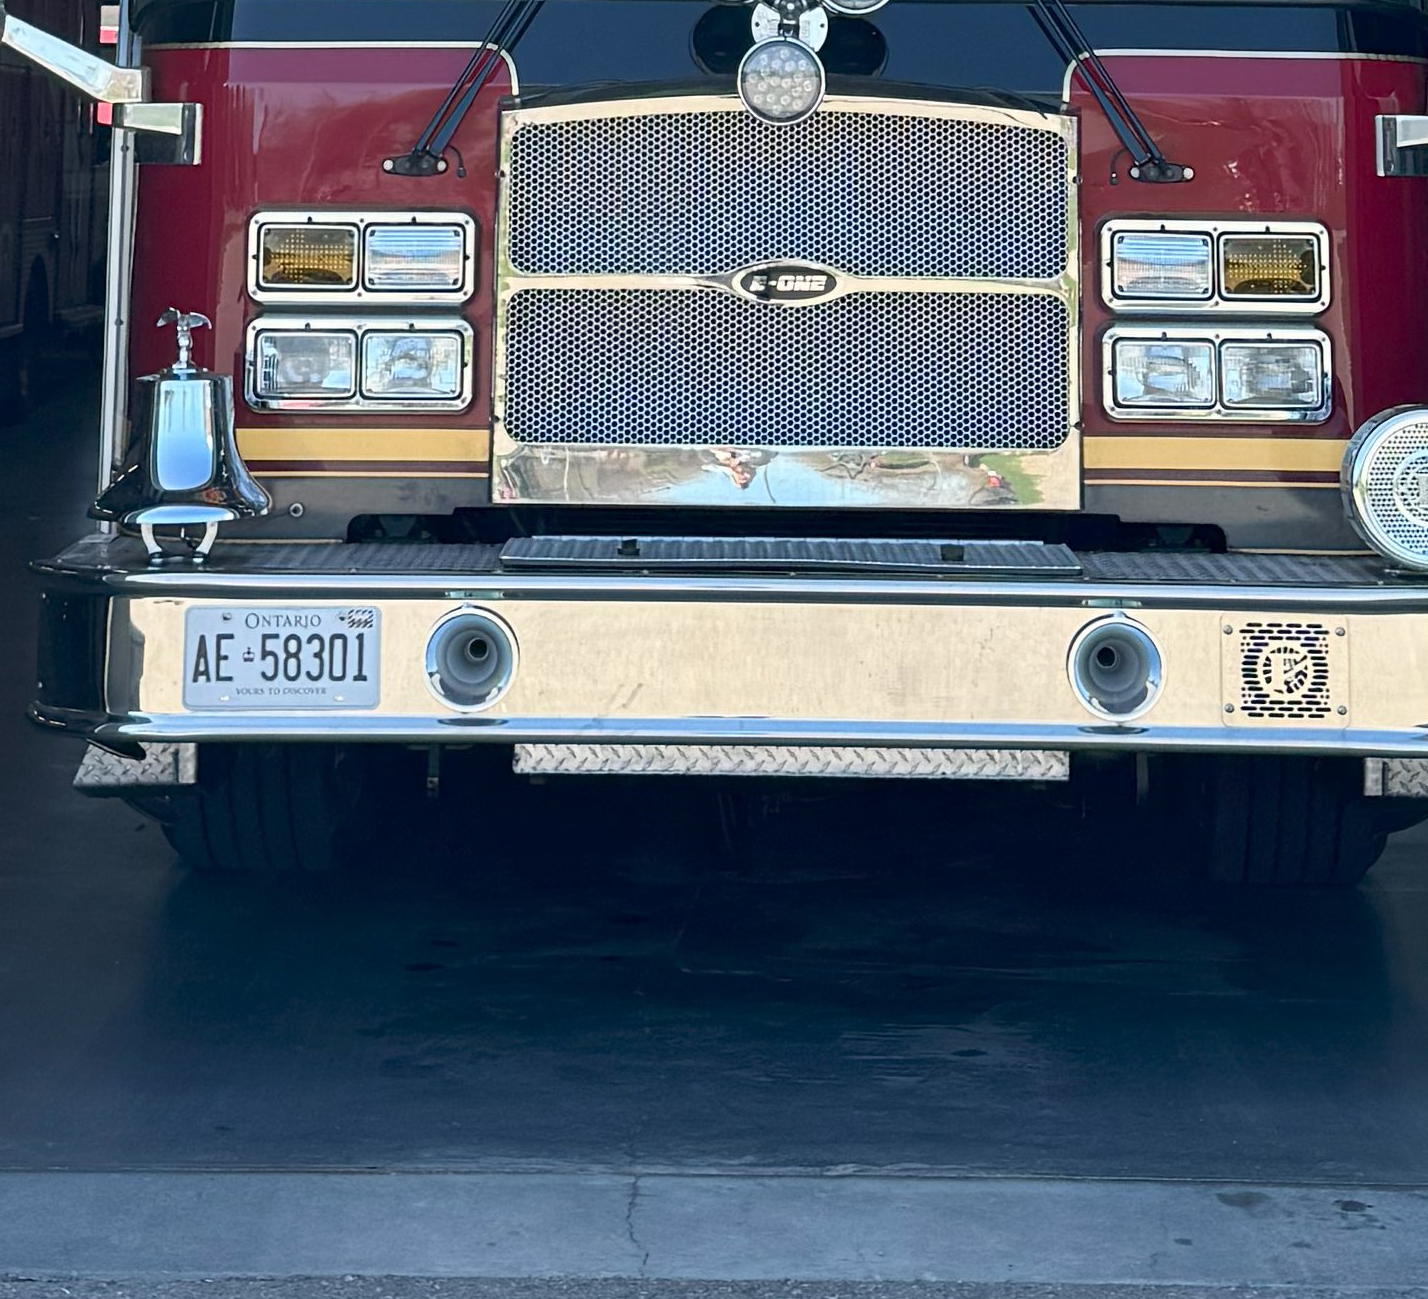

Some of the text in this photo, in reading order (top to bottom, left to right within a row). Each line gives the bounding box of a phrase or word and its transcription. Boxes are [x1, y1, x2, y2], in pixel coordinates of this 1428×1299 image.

[749, 275, 828, 292] E-ONE
[245, 612, 322, 629] ONTARIO
[192, 632, 368, 683] AE 58301
[236, 687, 327, 695] YOURS TO DISCOVER
